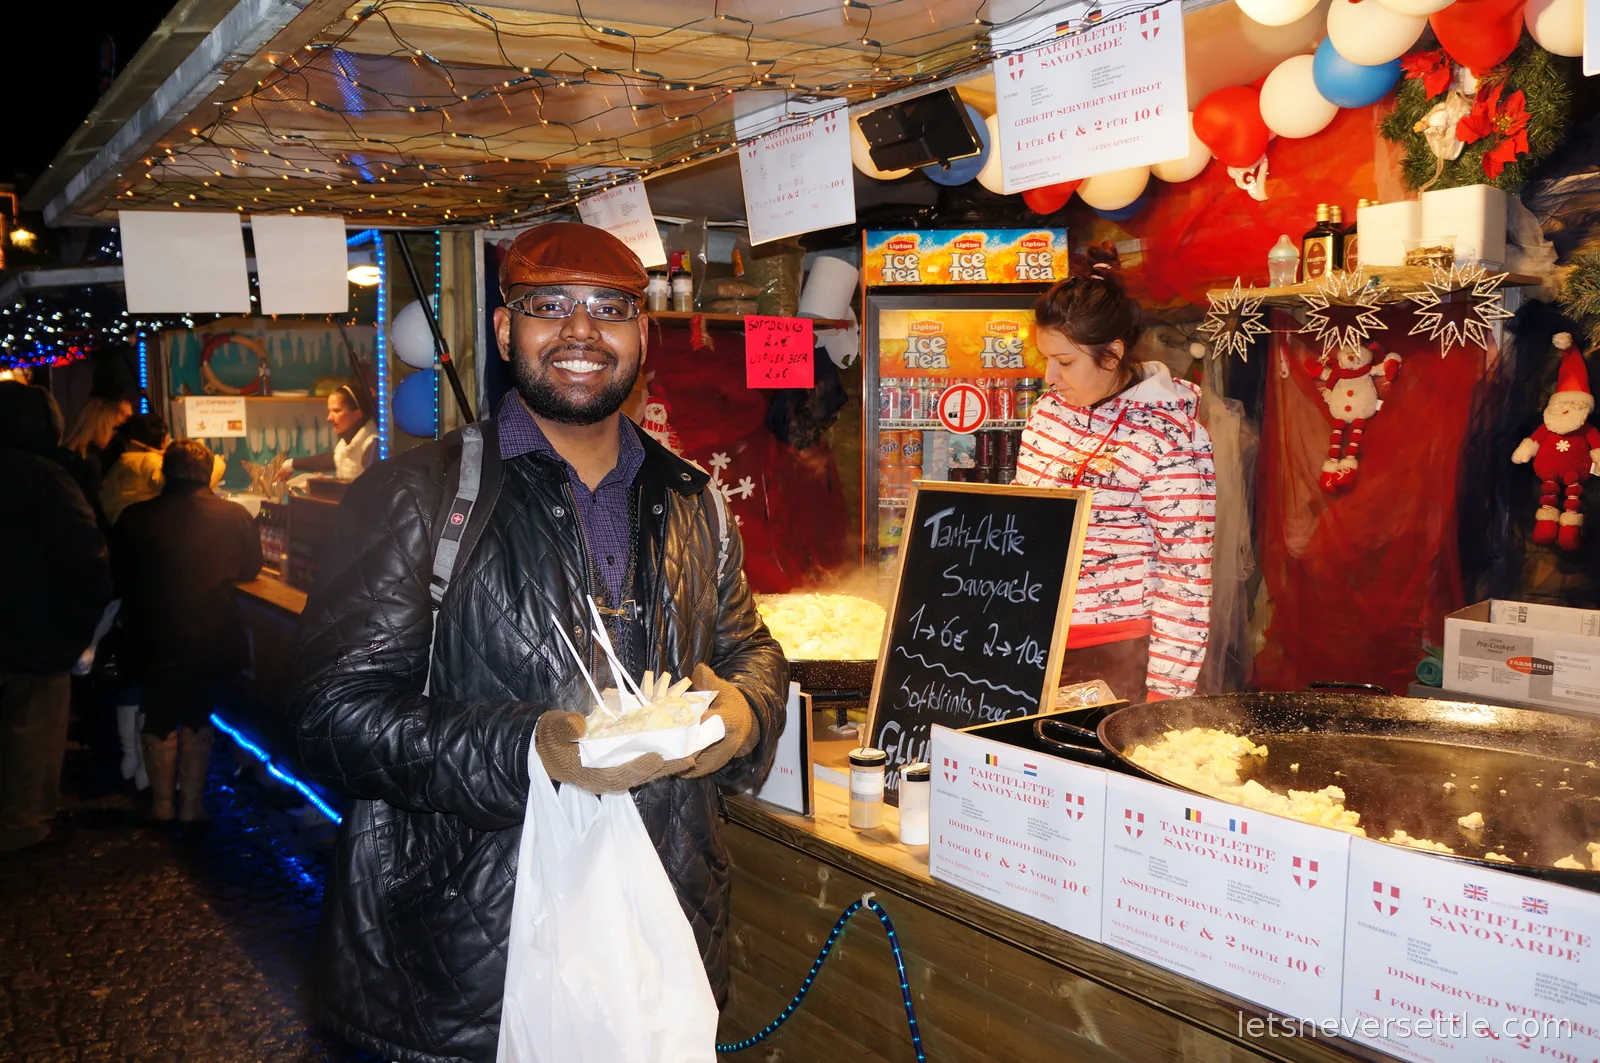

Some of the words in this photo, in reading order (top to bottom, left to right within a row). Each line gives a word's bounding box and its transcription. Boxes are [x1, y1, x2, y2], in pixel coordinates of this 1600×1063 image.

[1035, 21, 1127, 57] TARTIFLETTE
[1040, 37, 1122, 70] SAVOYARDE
[1014, 110, 1055, 128] GERICHT
[1056, 97, 1106, 116] SERVIERT
[1108, 90, 1129, 103] MIT
[1131, 81, 1163, 96] BROT
[1016, 140, 1022, 152] 1
[1025, 138, 1044, 149] FÜR
[1075, 124, 1087, 137] &
[1094, 119, 1103, 131] 2
[1106, 116, 1128, 129] FÜR
[1133, 106, 1151, 123] 10
[765, 130, 814, 151] SAVOYARDE
[889, 242, 913, 250] Lipton
[955, 241, 980, 249] Lipton
[1022, 240, 1047, 248] Lipton
[883, 253, 920, 269] Ice
[949, 252, 987, 268] Ice
[1016, 251, 1054, 267] Ice
[881, 267, 922, 283] Tea
[948, 266, 989, 282] Tea
[1015, 265, 1056, 281] Tea
[912, 323, 940, 331] Lipton
[989, 323, 1017, 331] Lipton
[905, 335, 947, 353] Ice
[981, 335, 1024, 353] Ice
[903, 352, 950, 370] Tea
[979, 352, 1027, 370] Tea
[923, 506, 1025, 566] Tartiflette
[1476, 640, 1516, 652] Pre-Cooked
[1509, 659, 1532, 668] FARM
[968, 766, 1055, 798] TARTIFLETTE
[972, 780, 1050, 809] SAVOYARDE
[948, 818, 973, 833] BORD
[974, 827, 994, 840] MET
[995, 833, 1031, 852] BROOD
[1033, 844, 1076, 868] BEDIEND
[1159, 819, 1276, 862] TARTIFLETTE
[1163, 835, 1269, 875] SAVOYARDE
[947, 840, 971, 855] VOOR
[973, 847, 981, 859] 6
[999, 856, 1011, 869] &
[1017, 862, 1026, 874] 2
[1030, 868, 1057, 886] VOOR
[1062, 878, 1078, 893] 10
[1119, 877, 1174, 901] ASSIETTE
[1176, 894, 1222, 917] SERVIE
[1225, 911, 1259, 928] AVEC
[1262, 920, 1281, 935] DU
[1285, 930, 1321, 948] PAIN
[1422, 896, 1592, 949] TARTIFLETTE
[1116, 897, 1122, 909] 1
[1127, 904, 1160, 923] POUR
[1164, 914, 1174, 928] 6
[1179, 919, 1189, 933] €
[1199, 926, 1214, 941] &
[1225, 934, 1236, 949] 2
[1241, 943, 1279, 964] POUR
[1286, 956, 1308, 973] 10
[1314, 964, 1326, 979] €
[1170, 942, 1188, 952] PAIN
[1429, 916, 1581, 964] SAVOYARDE
[1228, 962, 1245, 972] BON
[1387, 966, 1426, 986] DISH
[1430, 980, 1499, 1009] SERVED
[1505, 1002, 1554, 1023] WITH
[1373, 988, 1381, 1002] 1
[1390, 997, 1423, 1018] FOR
[1515, 1033, 1531, 1050] 2
[1540, 1044, 1579, 1063] FOR
